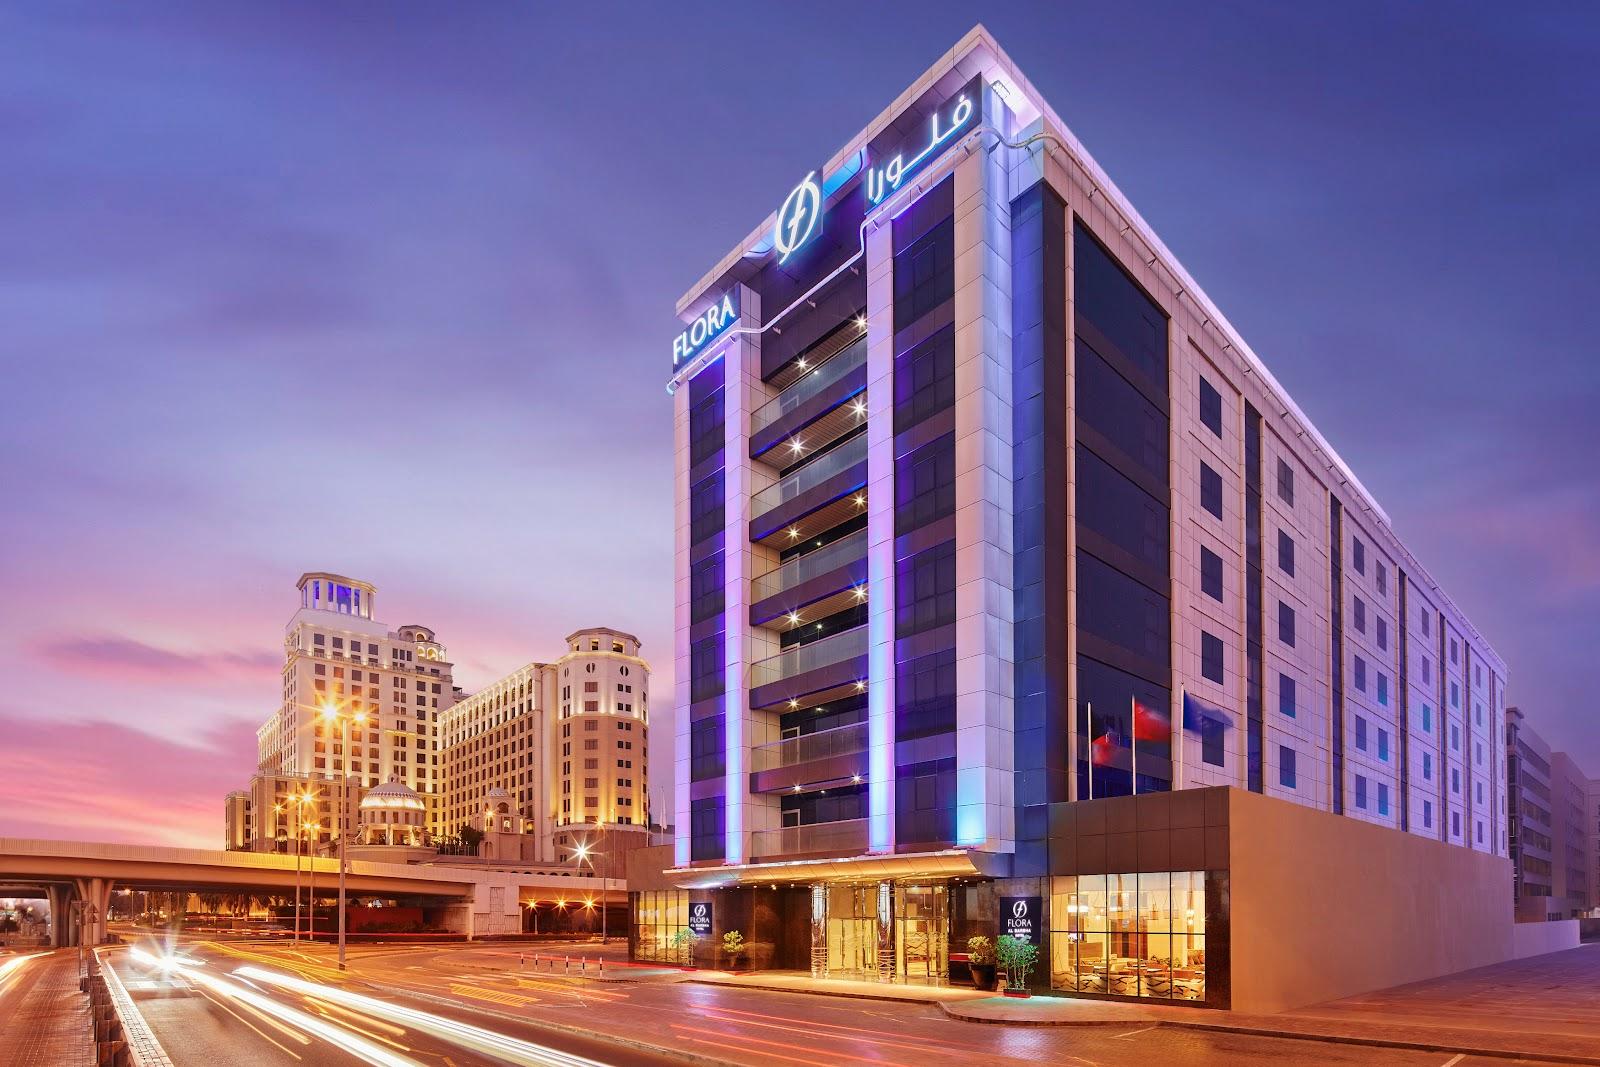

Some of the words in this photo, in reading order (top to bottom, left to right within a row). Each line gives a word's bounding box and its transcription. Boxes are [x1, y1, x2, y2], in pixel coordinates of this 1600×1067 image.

[866, 94, 973, 204] فلورا
[673, 294, 736, 365] FLORA
[1007, 919, 1032, 927] FLORA
